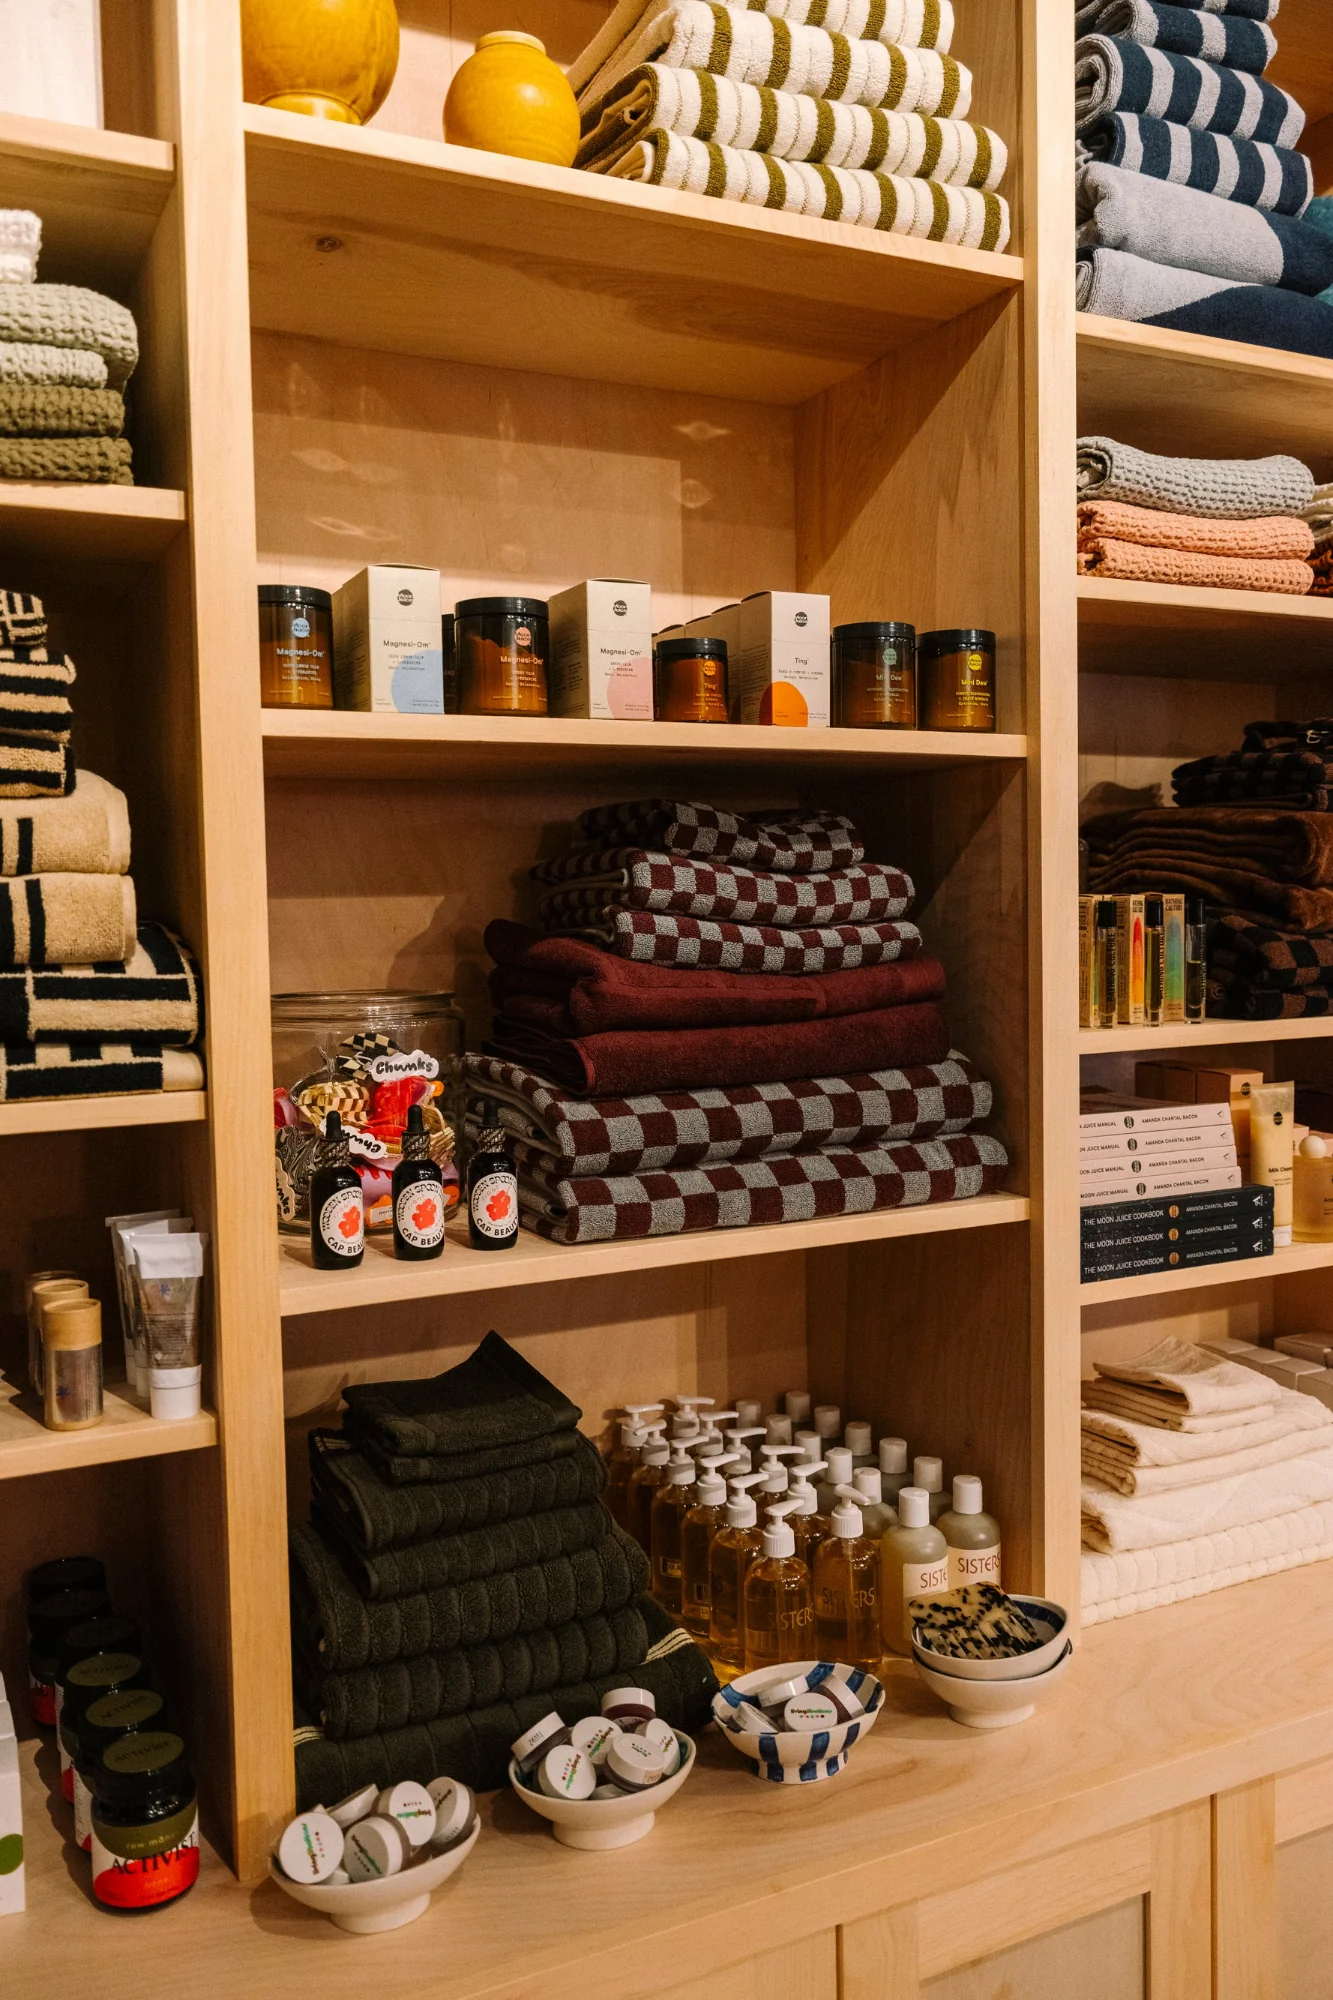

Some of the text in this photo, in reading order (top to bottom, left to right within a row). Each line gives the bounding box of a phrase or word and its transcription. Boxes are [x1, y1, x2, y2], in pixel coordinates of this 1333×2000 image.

[376, 1057, 433, 1074] Chunks
[342, 1130, 382, 1153] Chun
[398, 1188, 415, 1221] WOODEN
[473, 1180, 489, 1212] WOODEN
[322, 1196, 341, 1231] WOODEN
[1084, 1210, 1164, 1226] THE MOON JUICE COOKBOOK
[476, 1218, 491, 1232] CAP
[328, 1237, 344, 1251] CAP
[402, 1228, 418, 1242] CAP
[1084, 1232, 1164, 1249] THE MOON JUICE COOKBOOK
[1084, 1258, 1164, 1274] THE MOON JUICE COOKBOOK
[958, 1551, 1000, 1574] SISTERS
[823, 1587, 875, 1608] SIERS
[110, 1831, 195, 1875] ACTIVIST
